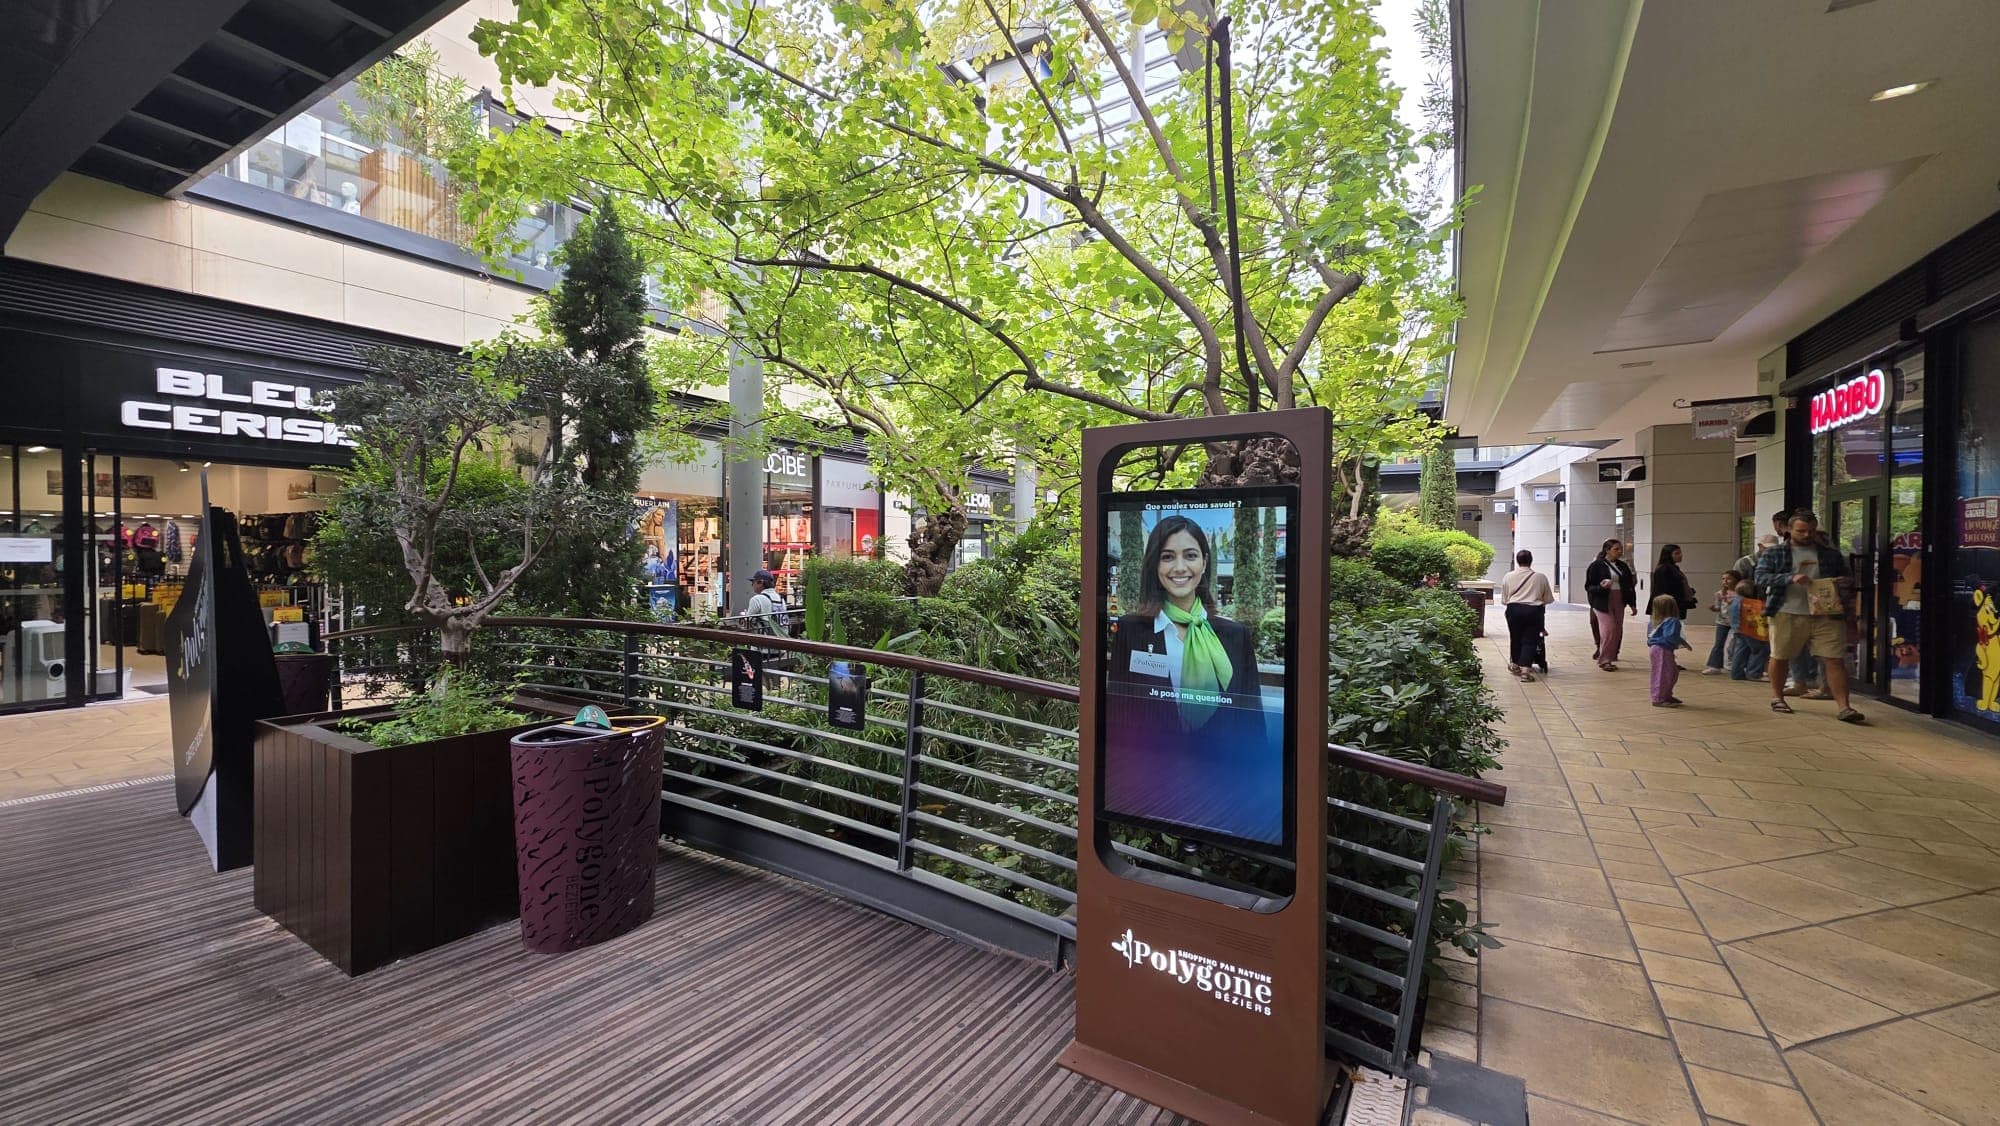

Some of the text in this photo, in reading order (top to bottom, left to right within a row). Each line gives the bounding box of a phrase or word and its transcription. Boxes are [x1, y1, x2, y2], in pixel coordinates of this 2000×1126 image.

[1811, 370, 1885, 433] HARIBO
[1699, 419, 1729, 427] HARIBO
[634, 499, 670, 509] GUERLAIN
[1162, 501, 1187, 510] voulez
[1210, 500, 1236, 509] savoir
[1149, 688, 1159, 696] Je
[1160, 691, 1180, 699] pose
[1196, 693, 1233, 705] question
[575, 776, 610, 920] Polygone
[1134, 940, 1272, 1005] Polygone
[1178, 950, 1272, 984] SHOPPING PAR NATURE
[1214, 990, 1272, 1017] BÉZIERS
